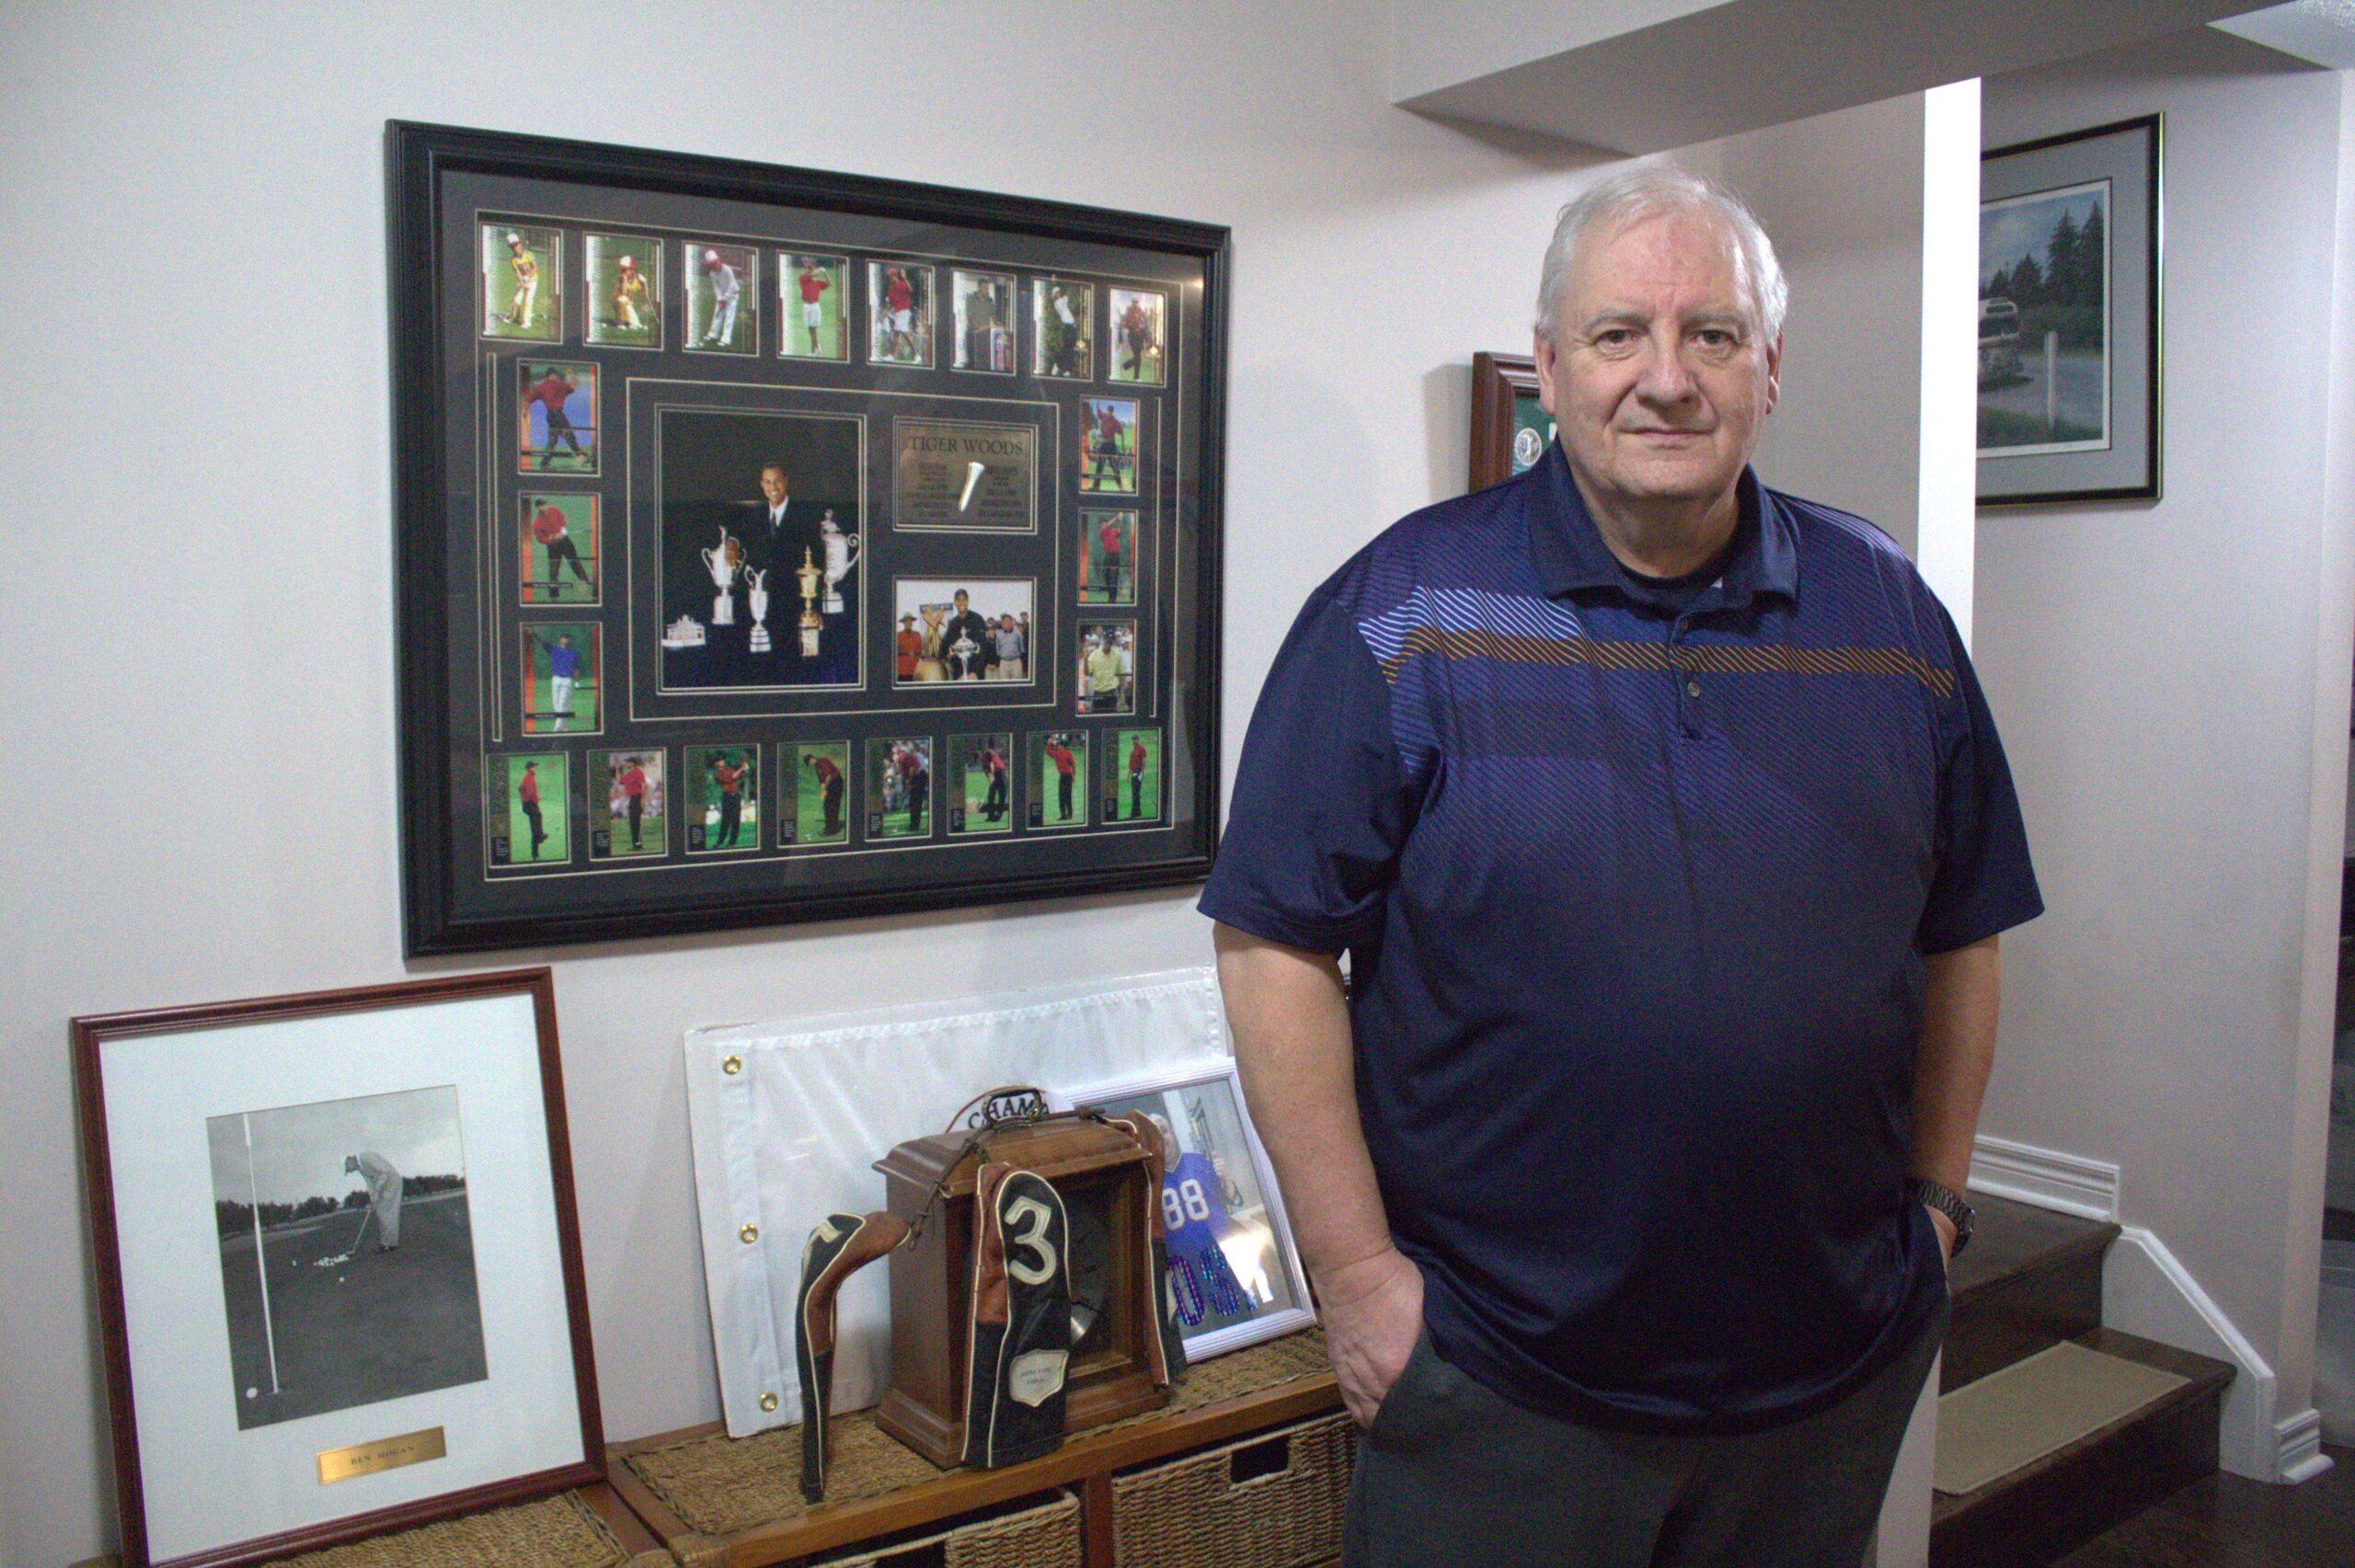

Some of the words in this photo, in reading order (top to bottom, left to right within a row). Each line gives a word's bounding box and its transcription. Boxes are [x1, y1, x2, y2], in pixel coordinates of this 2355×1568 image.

[912, 436, 958, 452] TIGER
[963, 438, 1023, 456] WOODS
[1162, 1178, 1210, 1230] 88
[1005, 1196, 1056, 1285] 3
[350, 1455, 372, 1465] BEN
